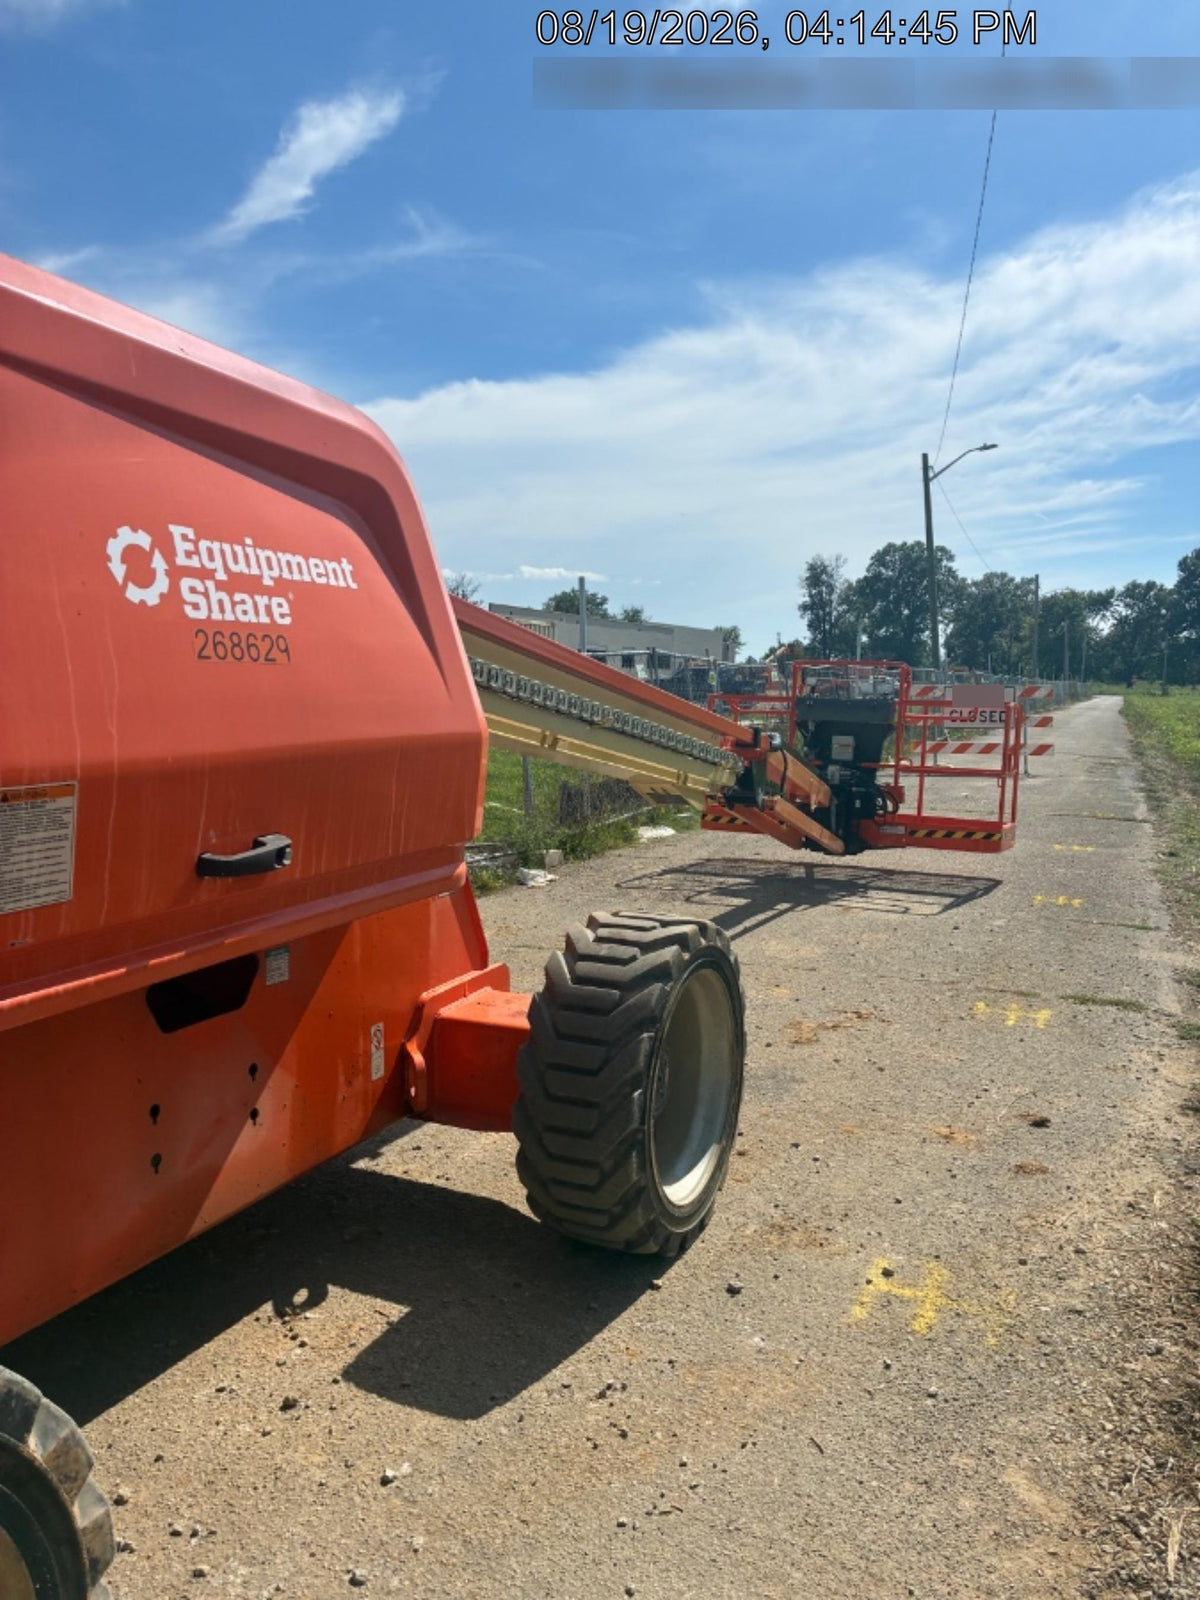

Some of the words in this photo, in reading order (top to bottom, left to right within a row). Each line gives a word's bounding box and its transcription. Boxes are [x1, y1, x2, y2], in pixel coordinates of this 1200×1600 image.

[168, 523, 358, 589] Equipment
[179, 576, 292, 625] Share
[194, 628, 290, 662] 268629
[949, 709, 1009, 723] CLOSED
